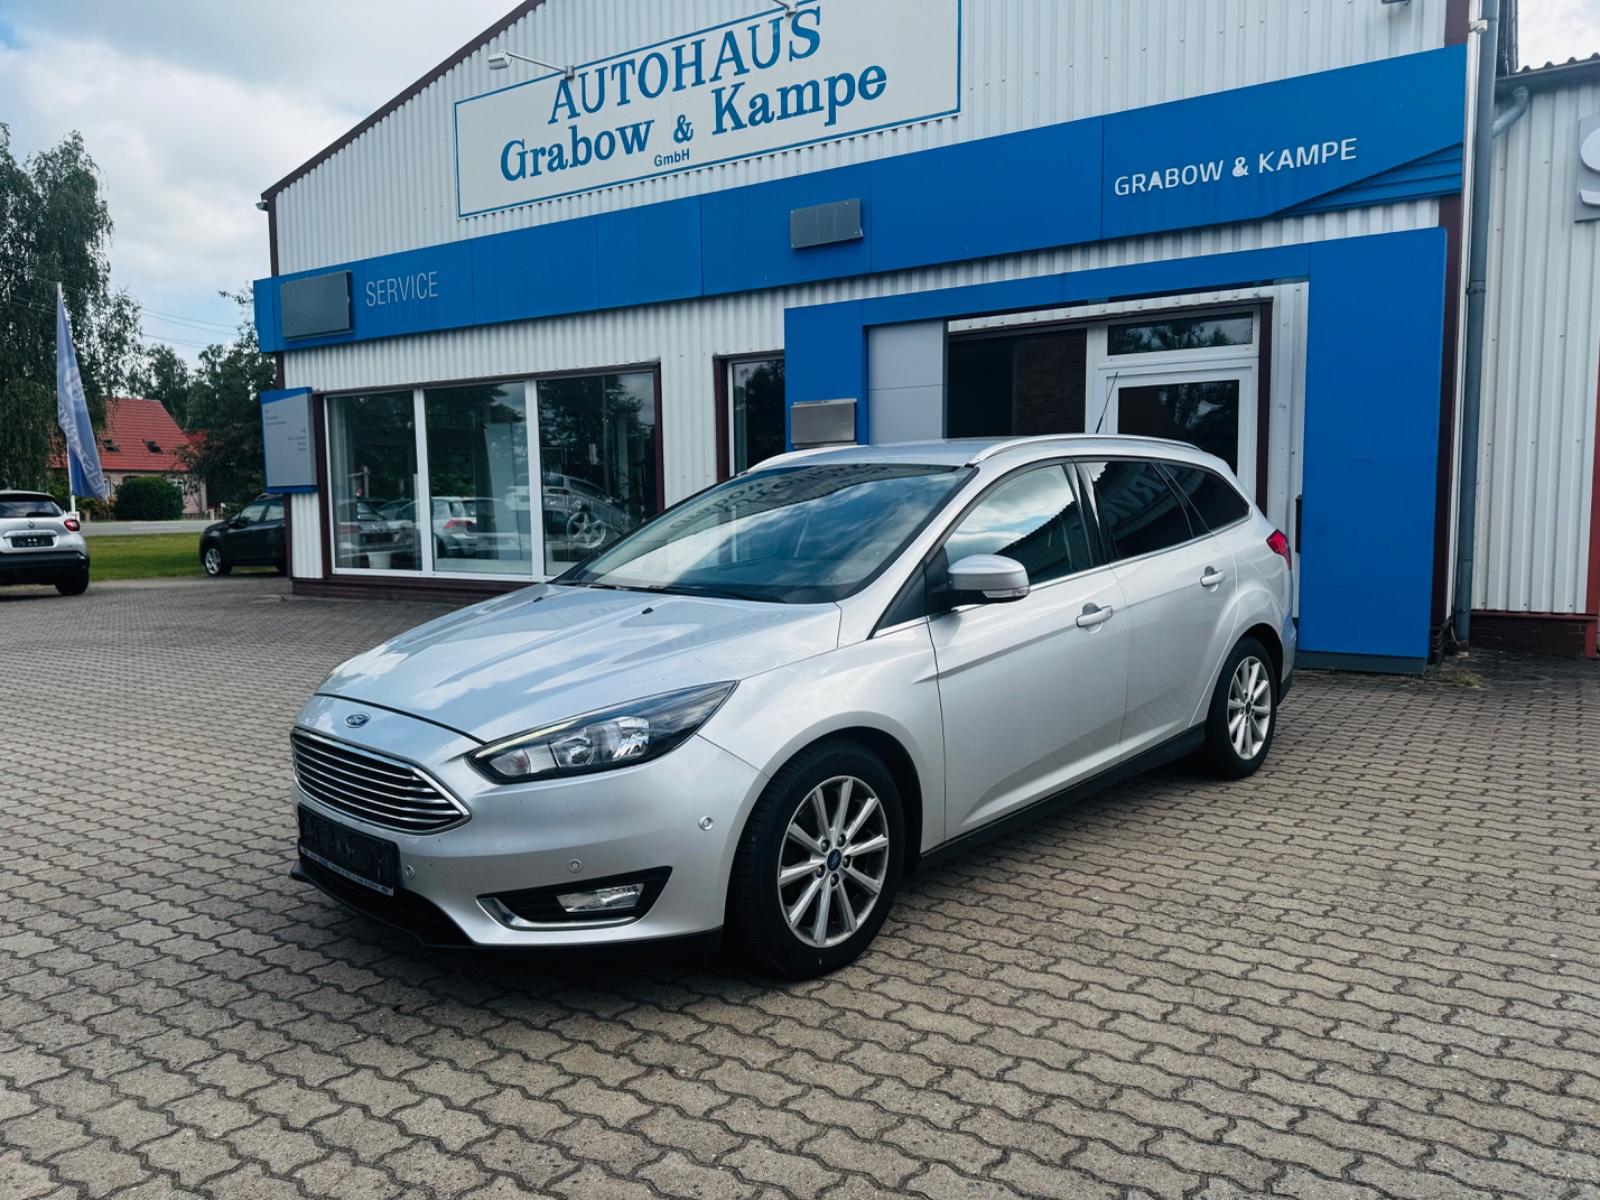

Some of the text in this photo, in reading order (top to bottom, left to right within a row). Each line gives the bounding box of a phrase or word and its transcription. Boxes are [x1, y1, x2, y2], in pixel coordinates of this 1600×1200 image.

[548, 6, 821, 124] AUTOHAUS
[500, 65, 887, 182] Grabow & Kampe
[653, 148, 690, 168] GmbH
[1114, 137, 1357, 196] GRABOW & KAMPE
[365, 271, 438, 307] SERVICE
